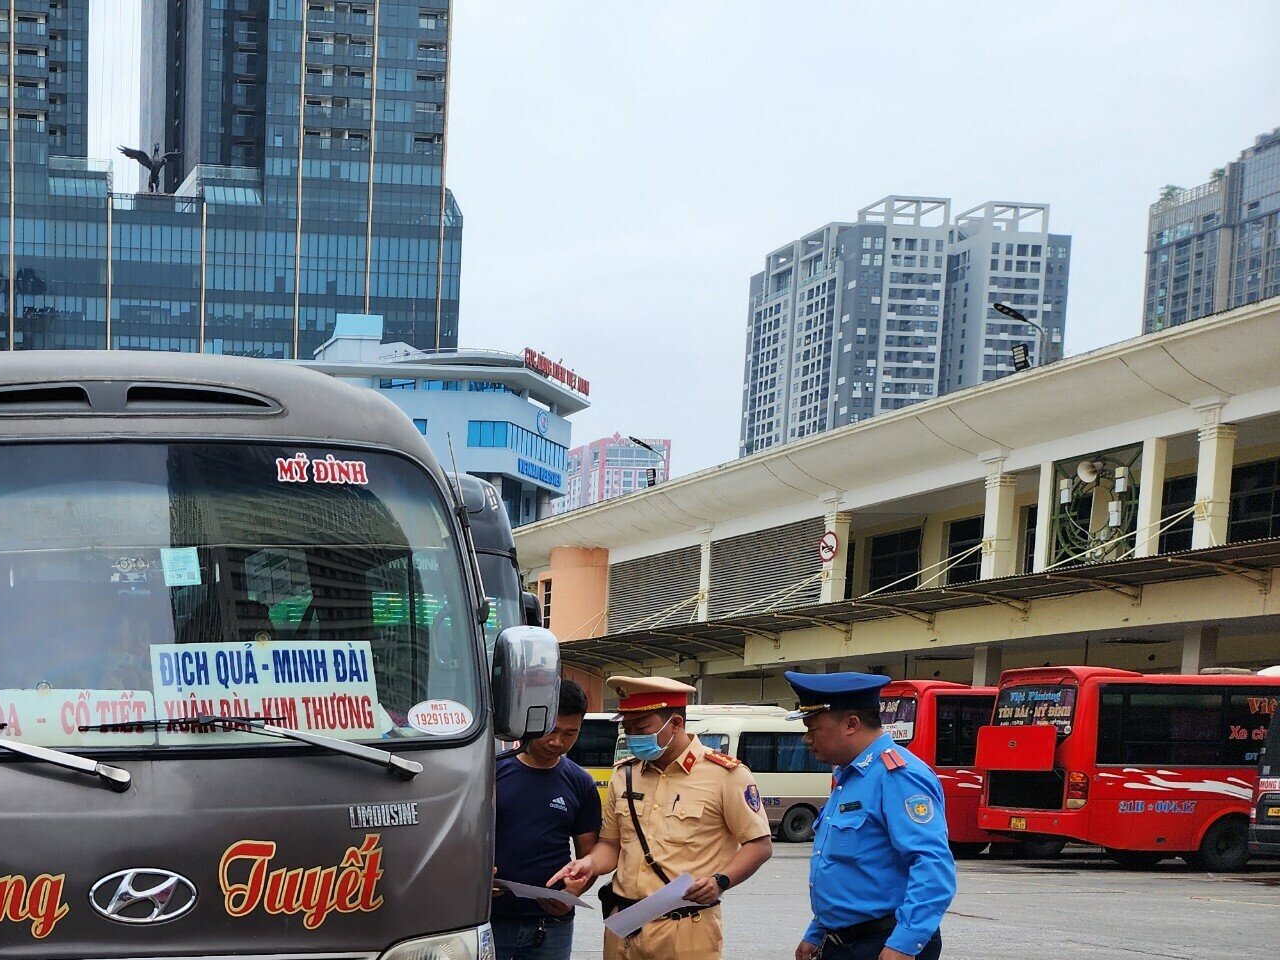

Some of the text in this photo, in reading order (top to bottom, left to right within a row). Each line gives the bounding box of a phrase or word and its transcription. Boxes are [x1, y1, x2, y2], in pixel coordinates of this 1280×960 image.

[276, 452, 368, 484] MỸ ĐÌNH
[159, 650, 210, 692] ĐỊCH
[216, 643, 259, 689] QUẢ
[274, 648, 329, 684] MINH
[333, 642, 369, 682] ĐÀI
[60, 692, 91, 735] CỔ
[96, 690, 147, 733] TIẾT
[164, 692, 217, 734] XUÂN
[301, 691, 376, 730] THƯƠNG
[415, 712, 468, 726] 19291613A
[431, 703, 448, 711] MST
[1229, 725, 1249, 740] Xe
[349, 803, 419, 829] LIMOUSINE
[219, 833, 385, 930] Tuyết
